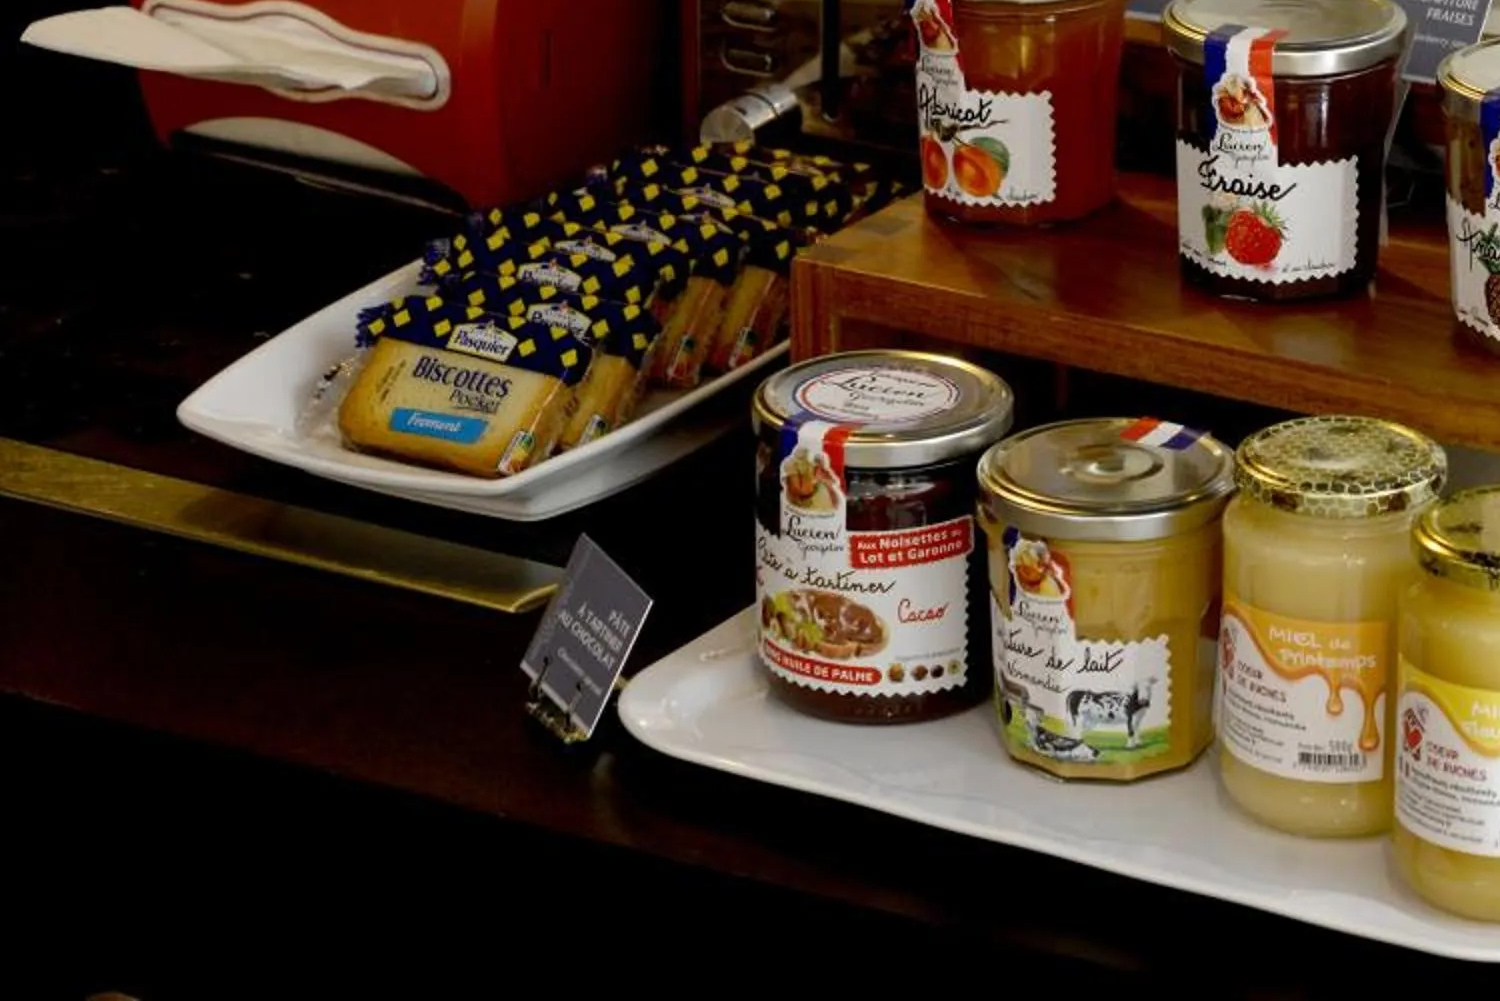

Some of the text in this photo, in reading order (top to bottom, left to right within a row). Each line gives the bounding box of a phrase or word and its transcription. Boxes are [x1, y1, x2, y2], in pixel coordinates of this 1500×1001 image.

[1427, 7, 1475, 26] FRAISES
[919, 83, 993, 129] Abricot
[1198, 154, 1297, 201] Fraise
[453, 330, 508, 356] Pasquier
[413, 355, 512, 397] Biscottes
[780, 515, 841, 542] Lucien
[880, 530, 948, 549] Noisettes
[861, 540, 962, 564] Lot et Garonne
[800, 566, 896, 593] tartiner
[898, 598, 949, 623] Cacao
[1269, 626, 1322, 648] MIEL
[1045, 646, 1075, 671] de
[1077, 646, 1123, 673] lait
[813, 666, 829, 678] DE
[831, 669, 873, 682] PALME
